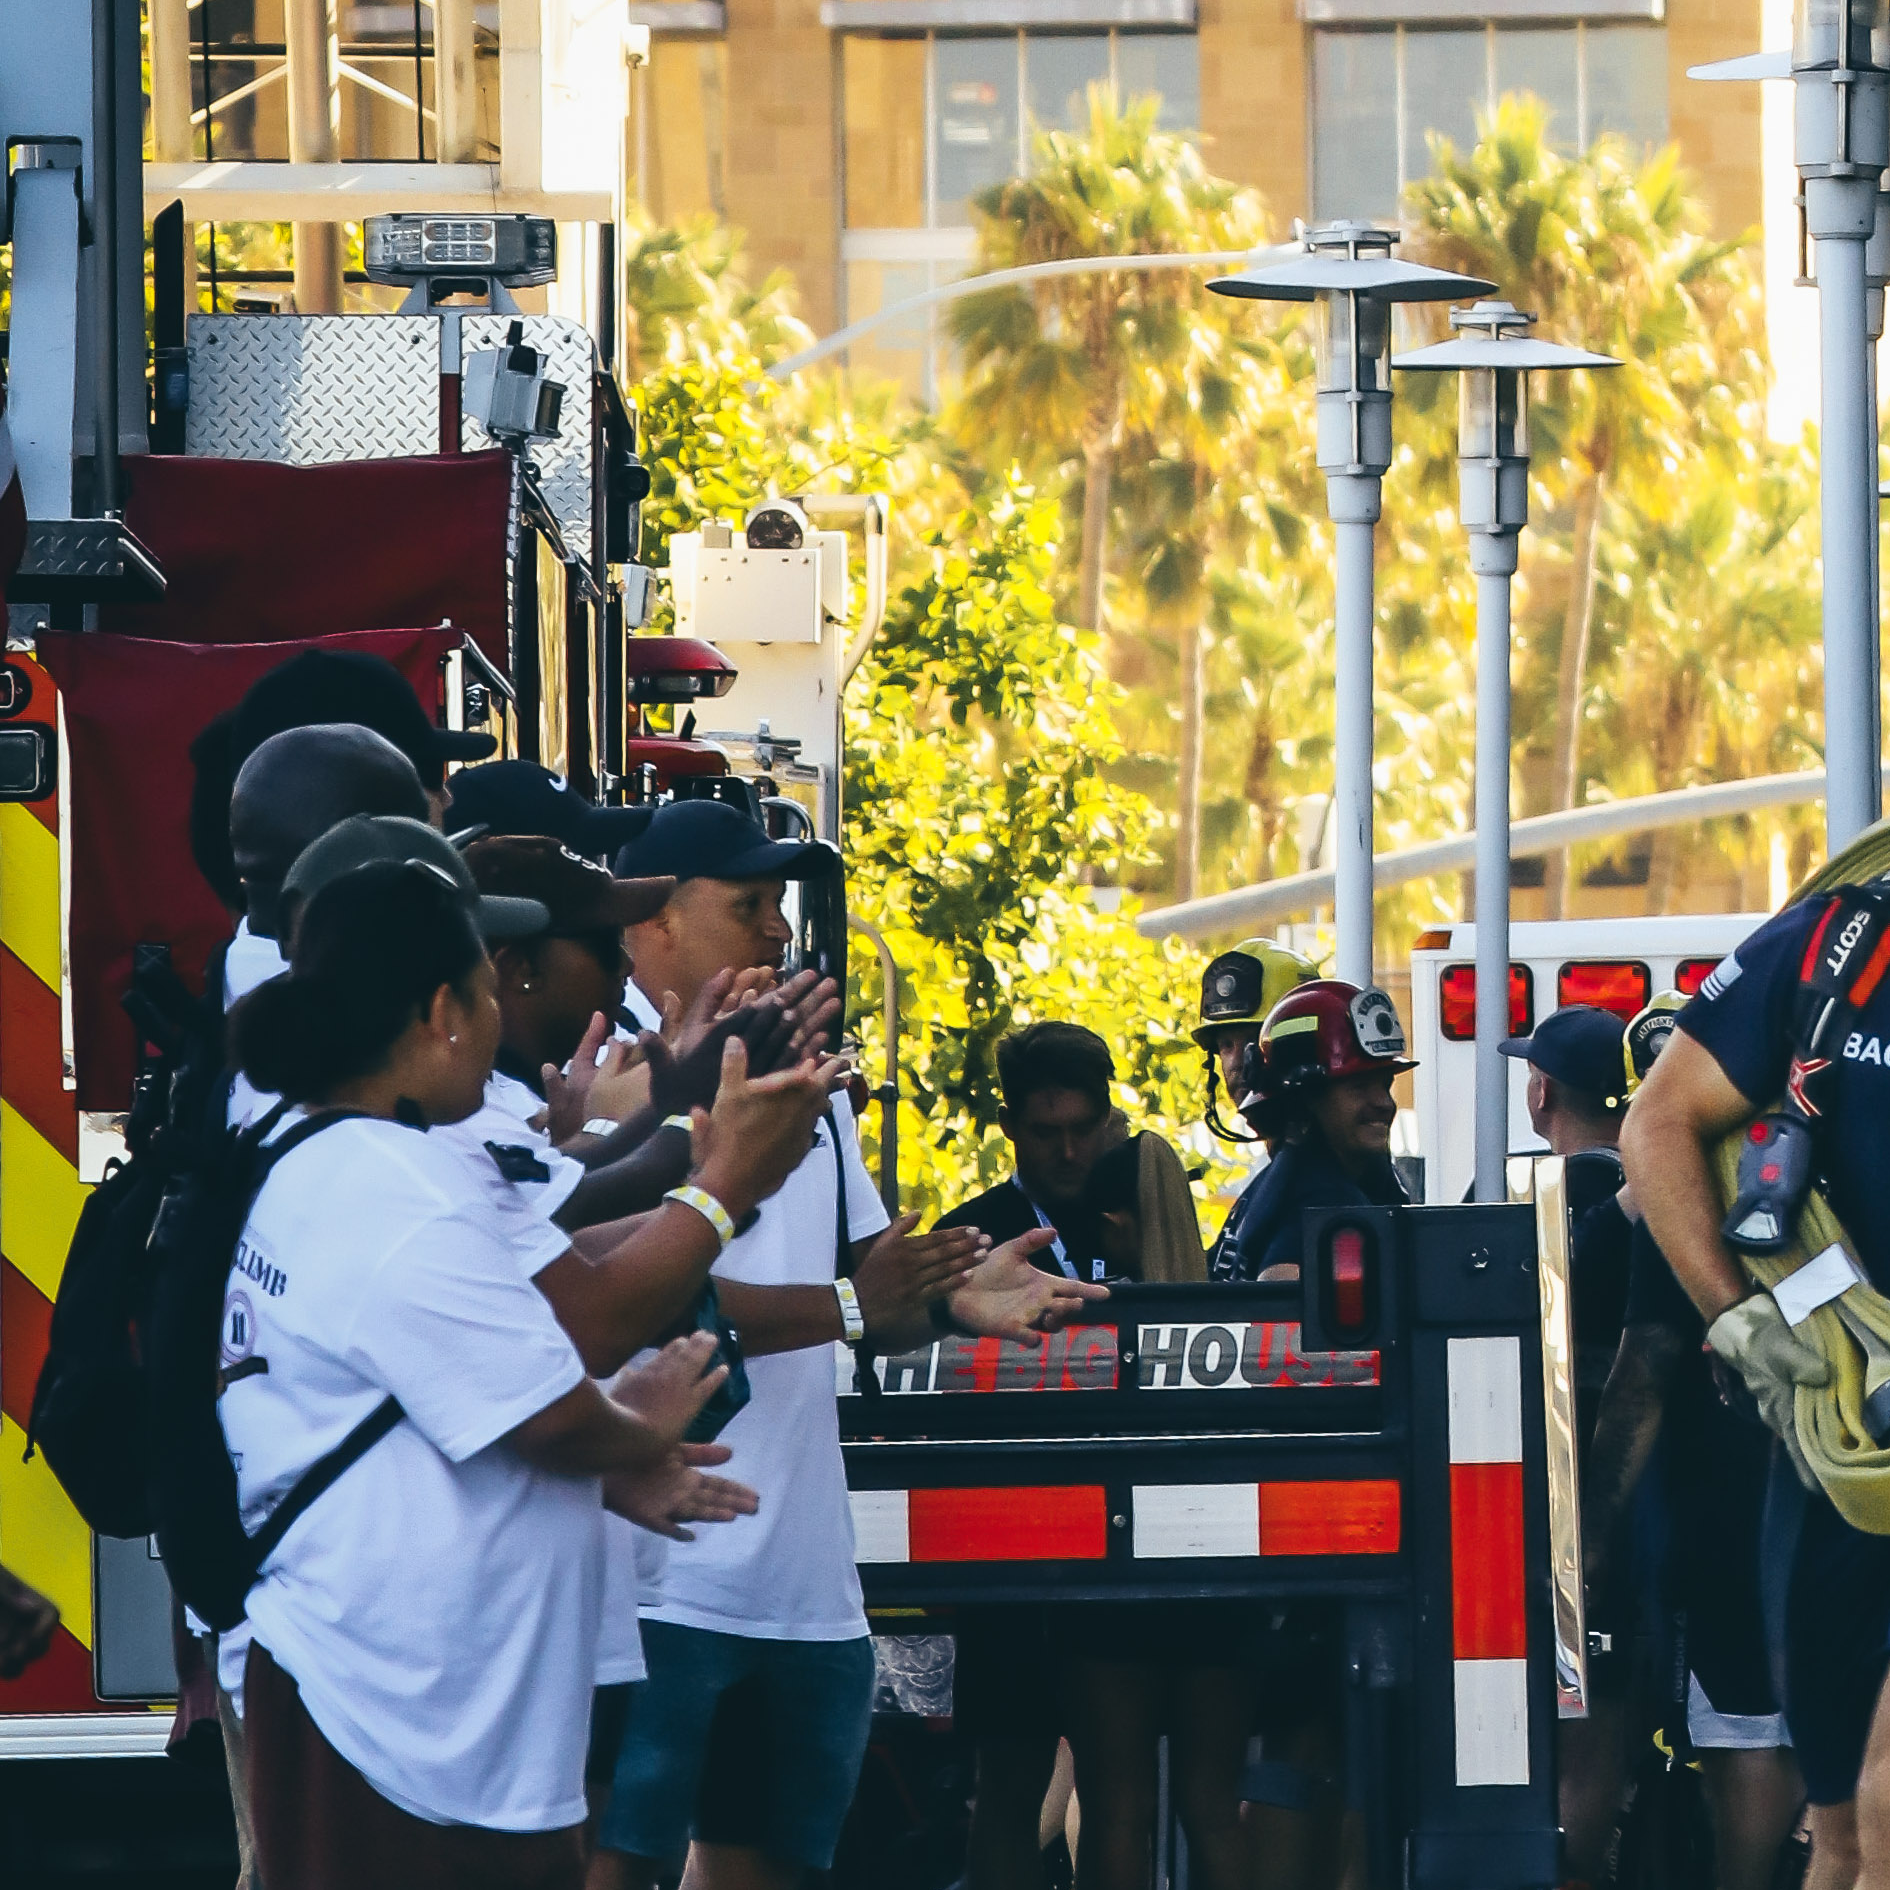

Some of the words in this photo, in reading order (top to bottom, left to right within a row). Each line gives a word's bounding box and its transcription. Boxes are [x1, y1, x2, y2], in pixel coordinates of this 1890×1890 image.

[1826, 910, 1872, 977] SCOTT
[992, 1327, 1119, 1392] BIG
[1139, 1325, 1378, 1387] HOUSE
